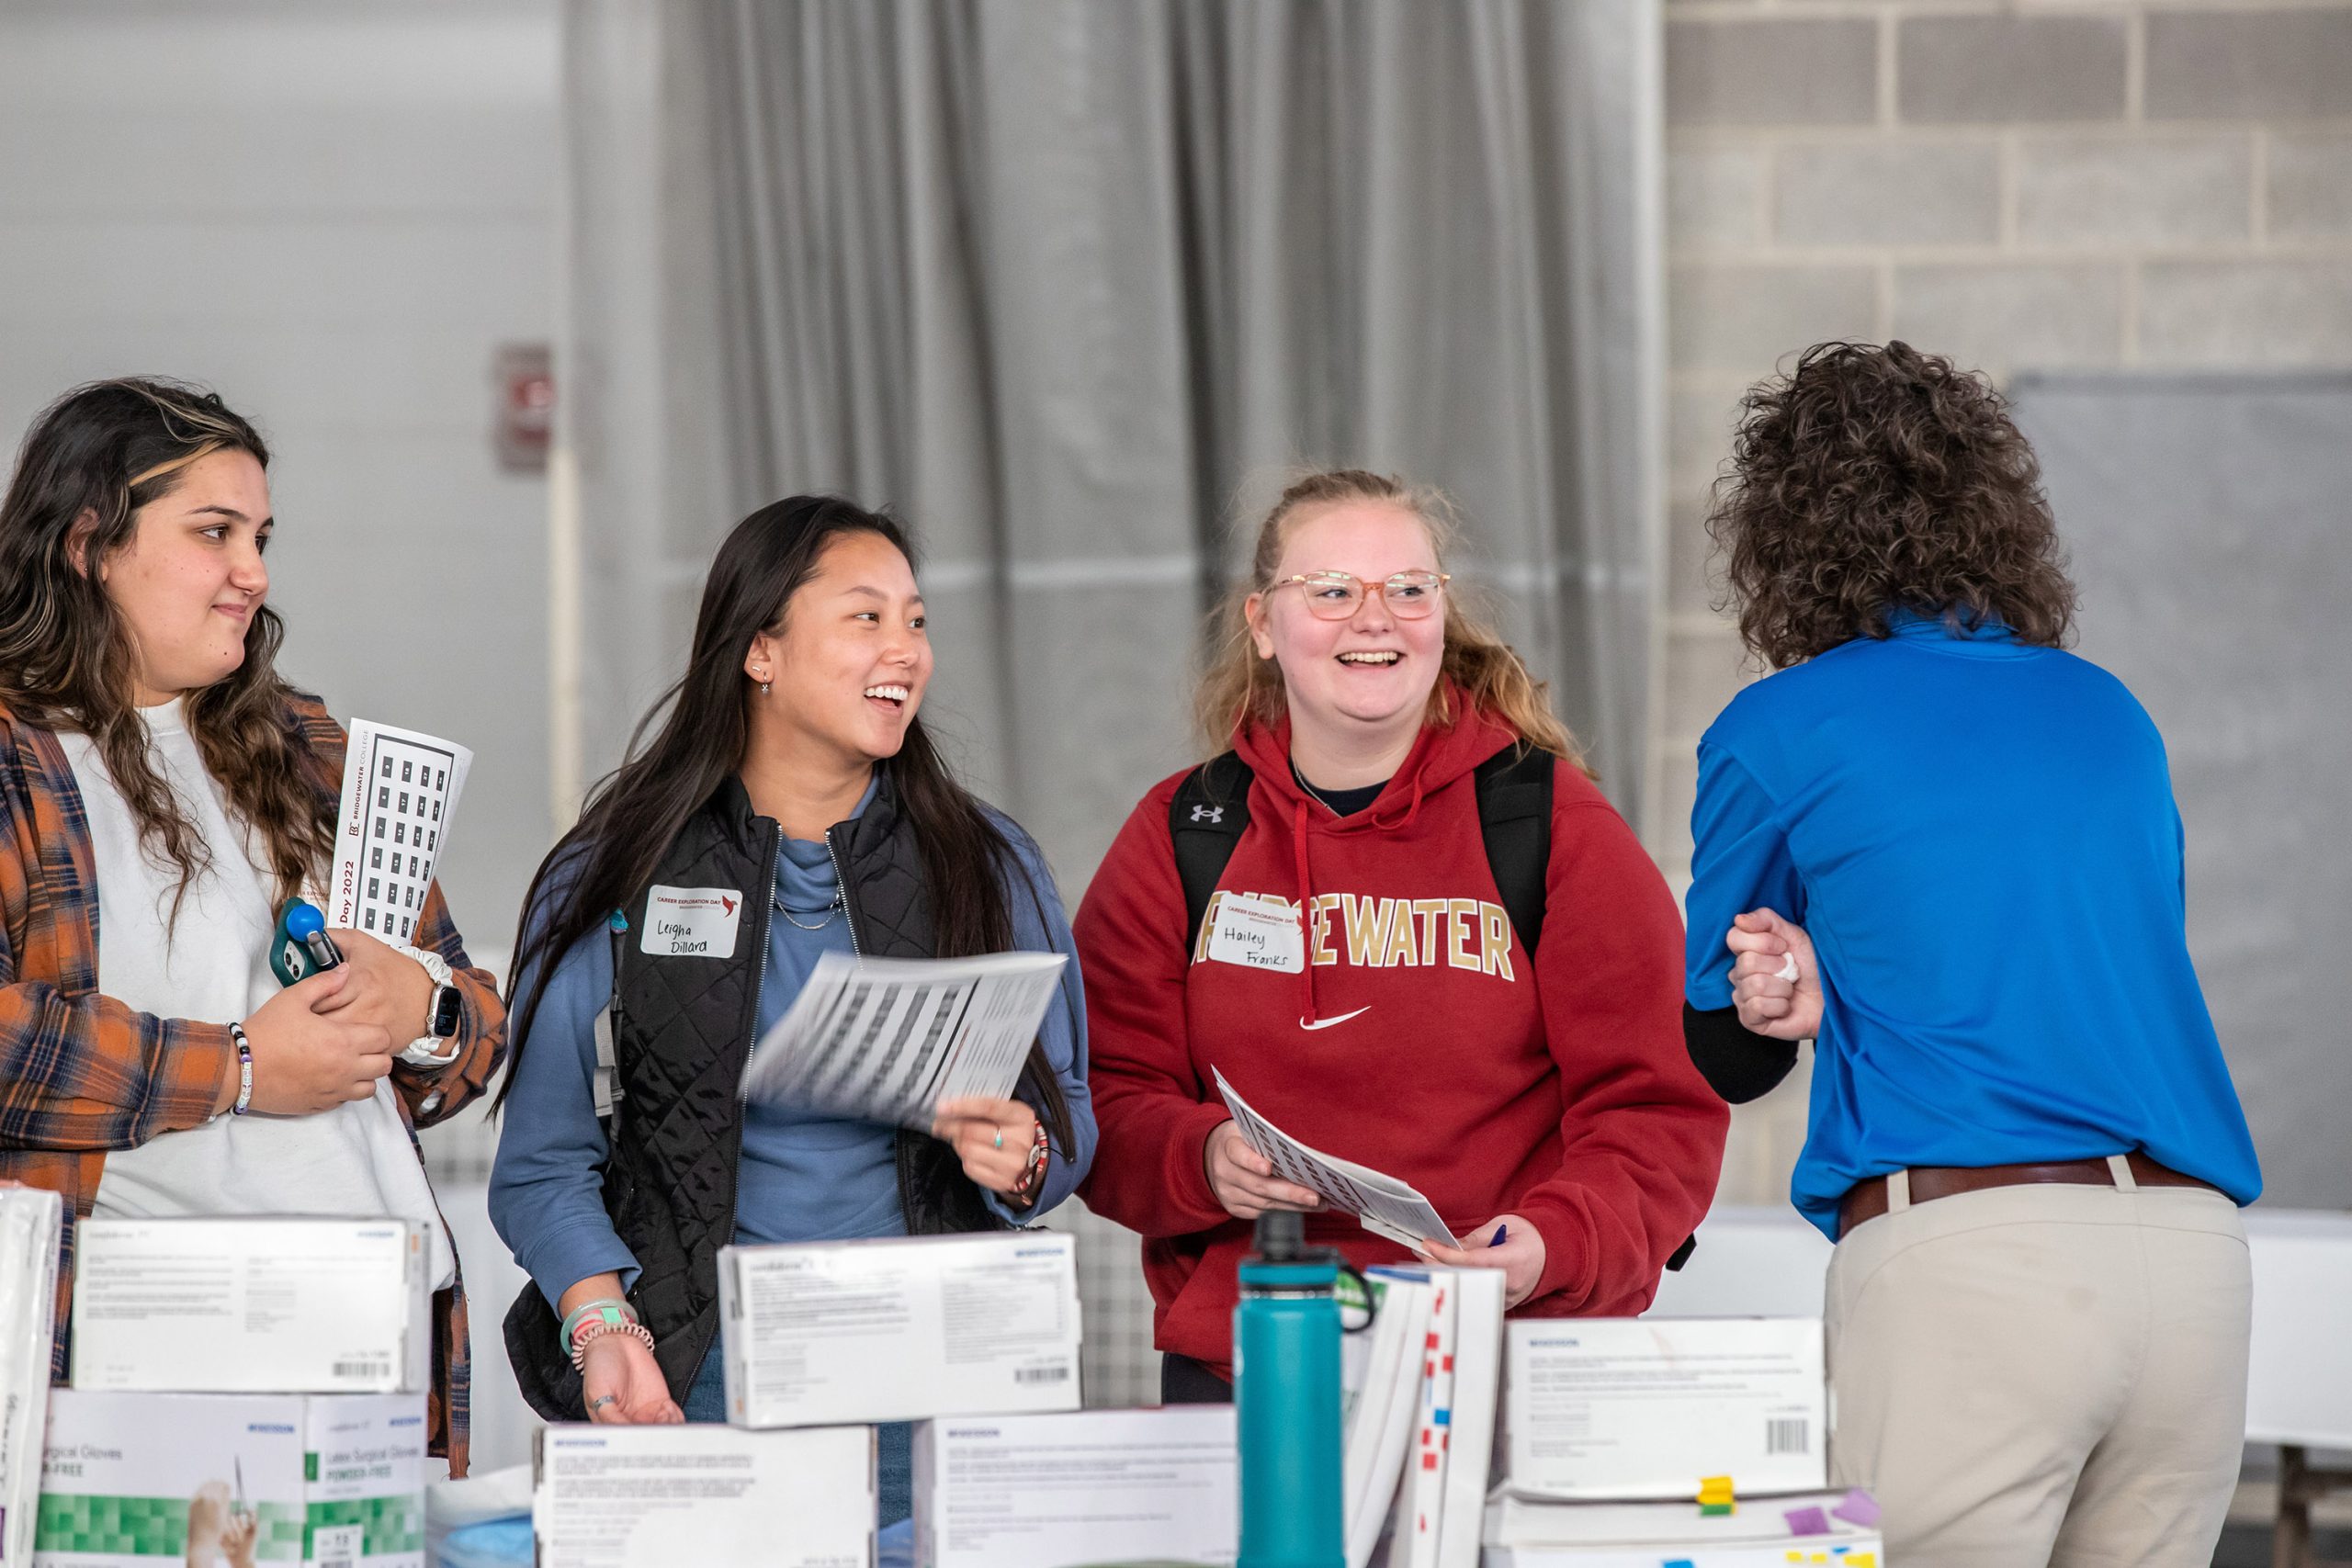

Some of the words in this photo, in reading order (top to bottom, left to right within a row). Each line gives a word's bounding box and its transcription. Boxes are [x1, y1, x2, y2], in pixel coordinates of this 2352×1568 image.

[353, 766, 365, 820] BRIDGEWATER
[359, 729, 369, 765] COLLEGE
[343, 861, 355, 896] 2022
[340, 898, 353, 924] Day
[1227, 906, 1248, 915] CAREER
[1248, 910, 1283, 922] EXPLORATION
[657, 919, 692, 941] Leigha
[1224, 927, 1265, 951] Hailey
[671, 941, 707, 953] Dillard
[1247, 951, 1288, 966] Franks
